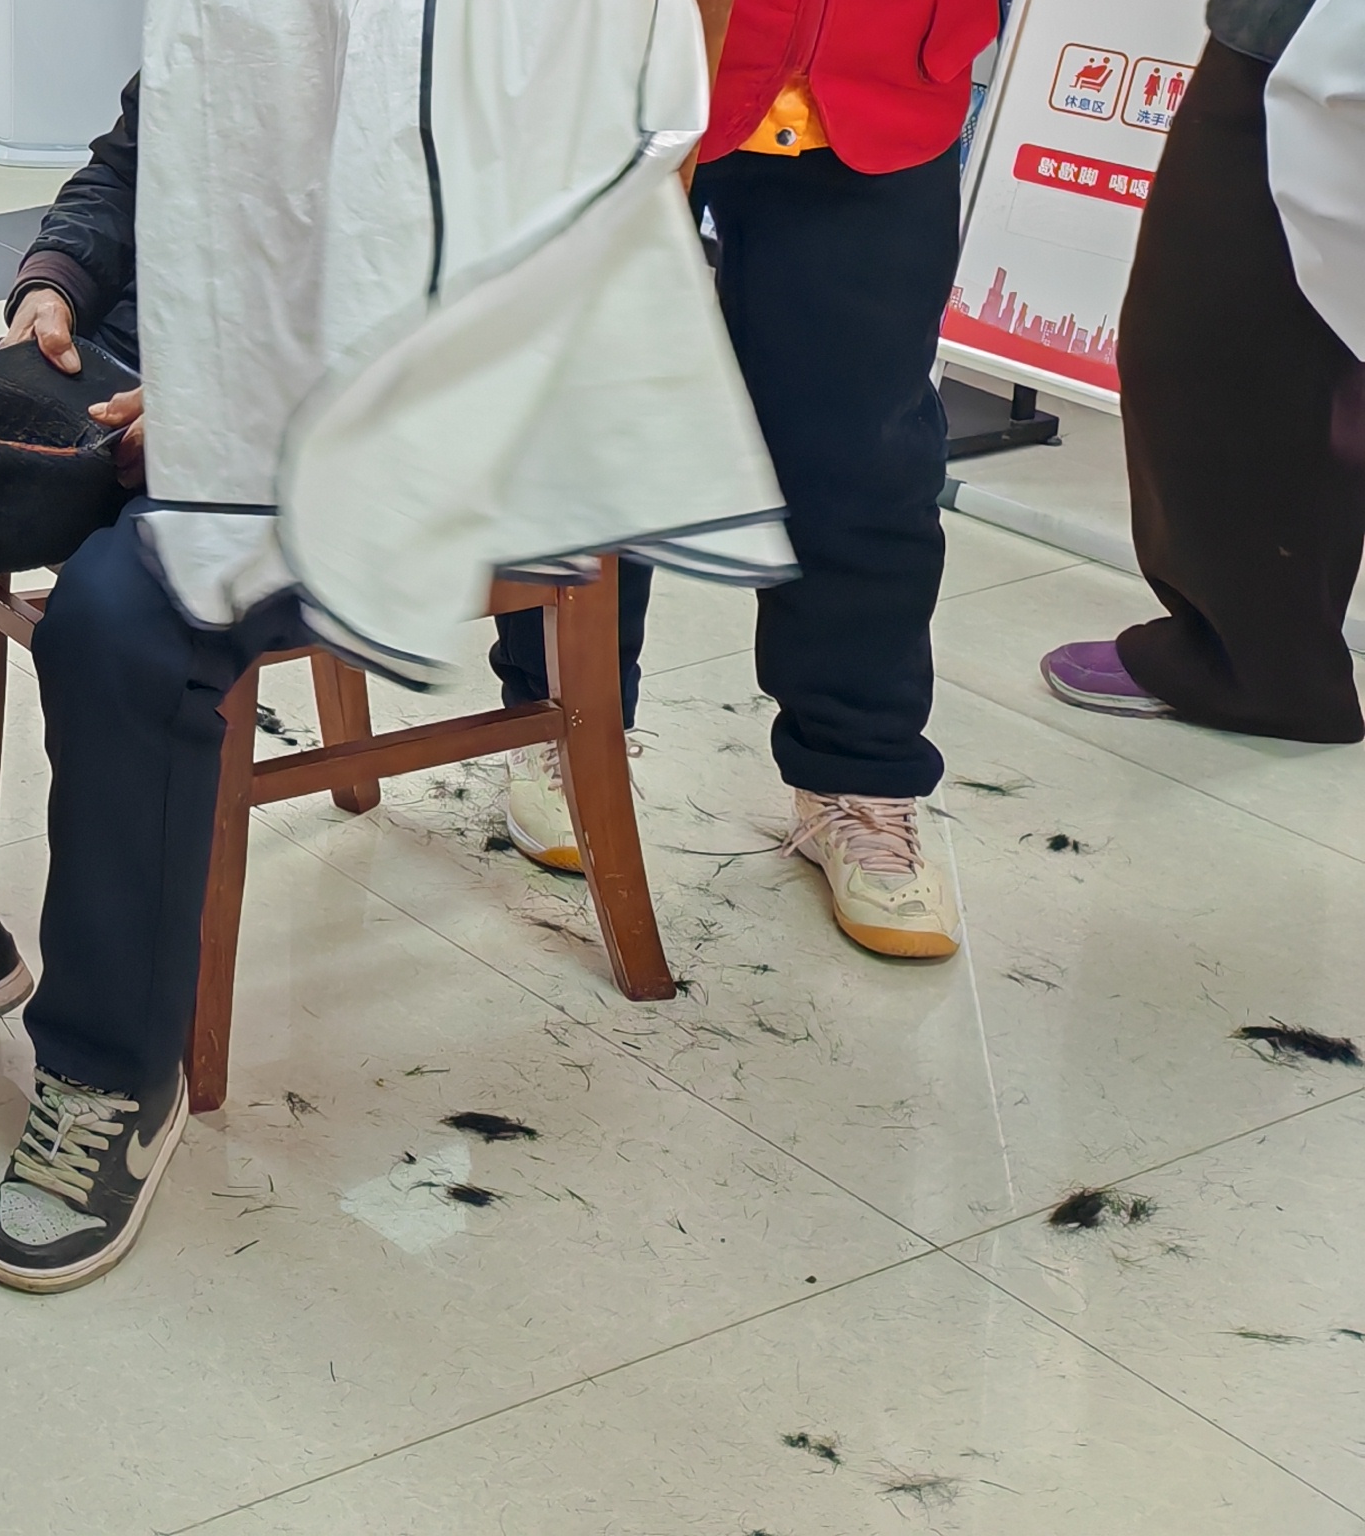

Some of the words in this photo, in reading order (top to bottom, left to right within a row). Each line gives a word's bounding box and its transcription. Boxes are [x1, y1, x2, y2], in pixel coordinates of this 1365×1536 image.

[1065, 95, 1106, 115] 休息区
[1037, 156, 1100, 187] 歇歇脚
